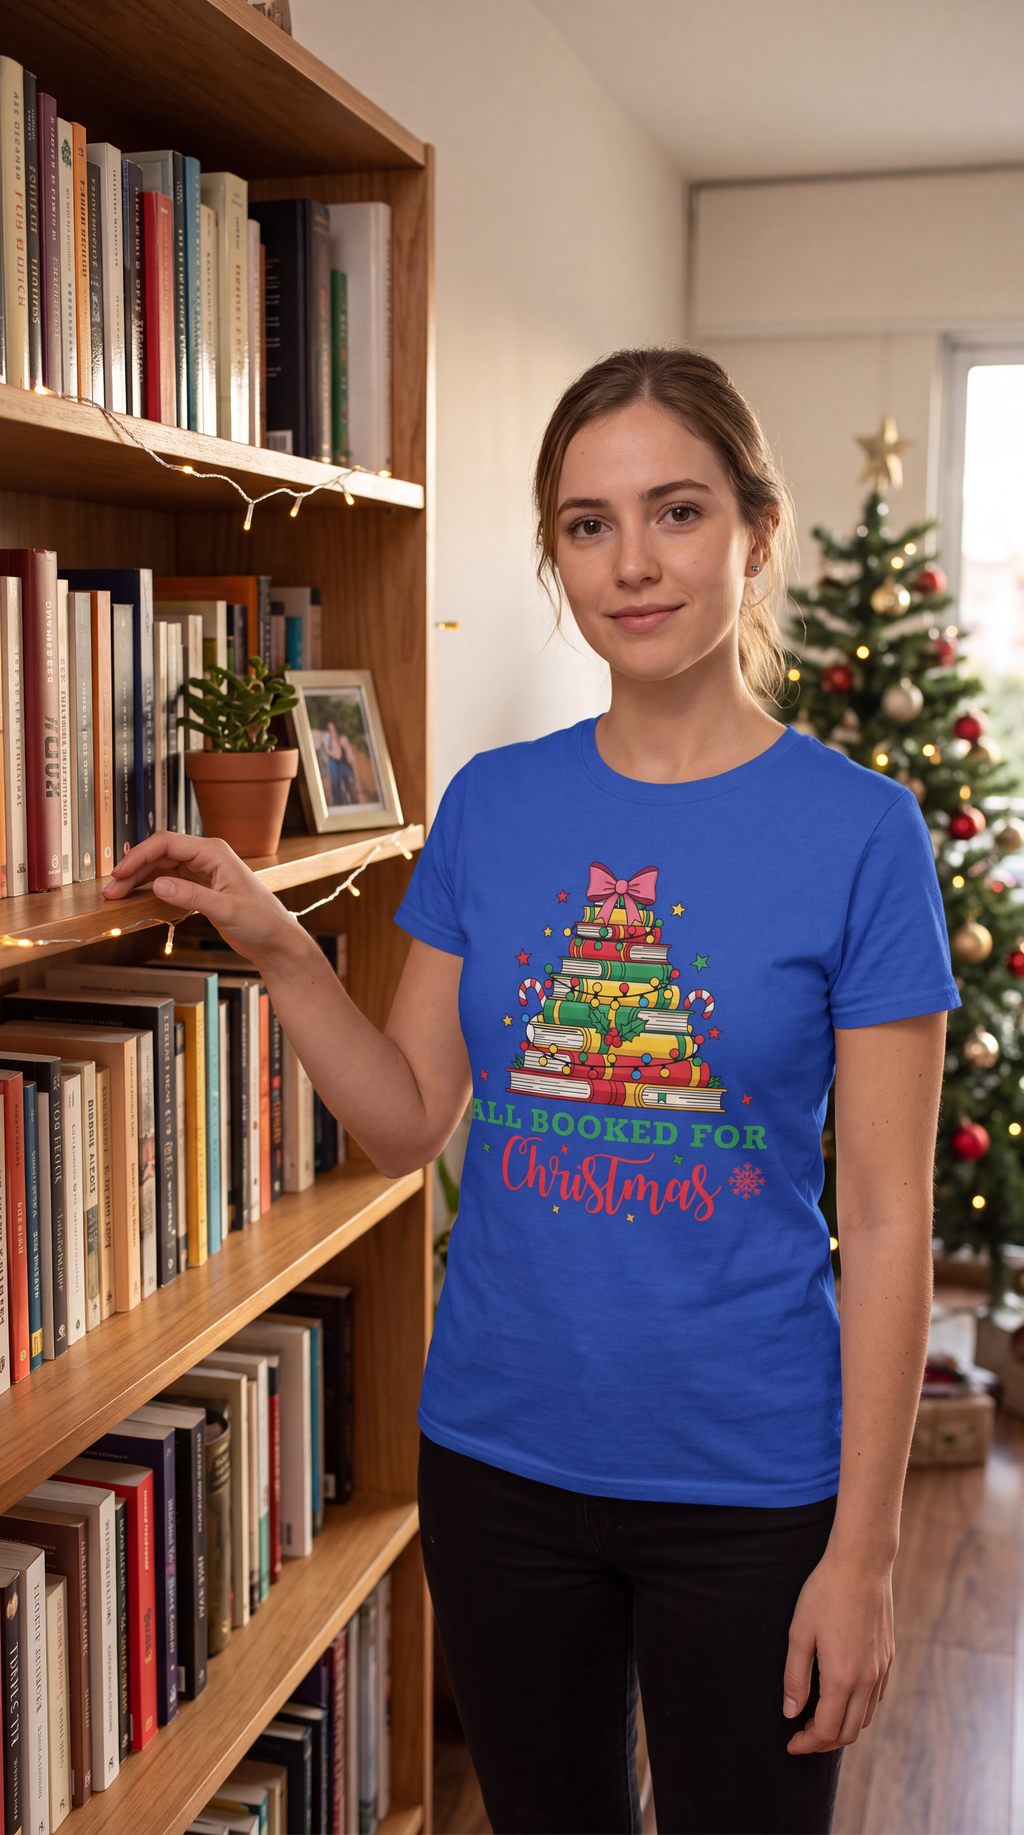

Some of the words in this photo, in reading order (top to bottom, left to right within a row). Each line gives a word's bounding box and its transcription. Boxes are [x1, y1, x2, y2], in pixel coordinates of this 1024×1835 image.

[472, 1098, 522, 1129] ALL
[531, 1108, 678, 1146] BOOKED
[690, 1124, 768, 1150] FOR
[502, 1135, 722, 1221] Christmas
